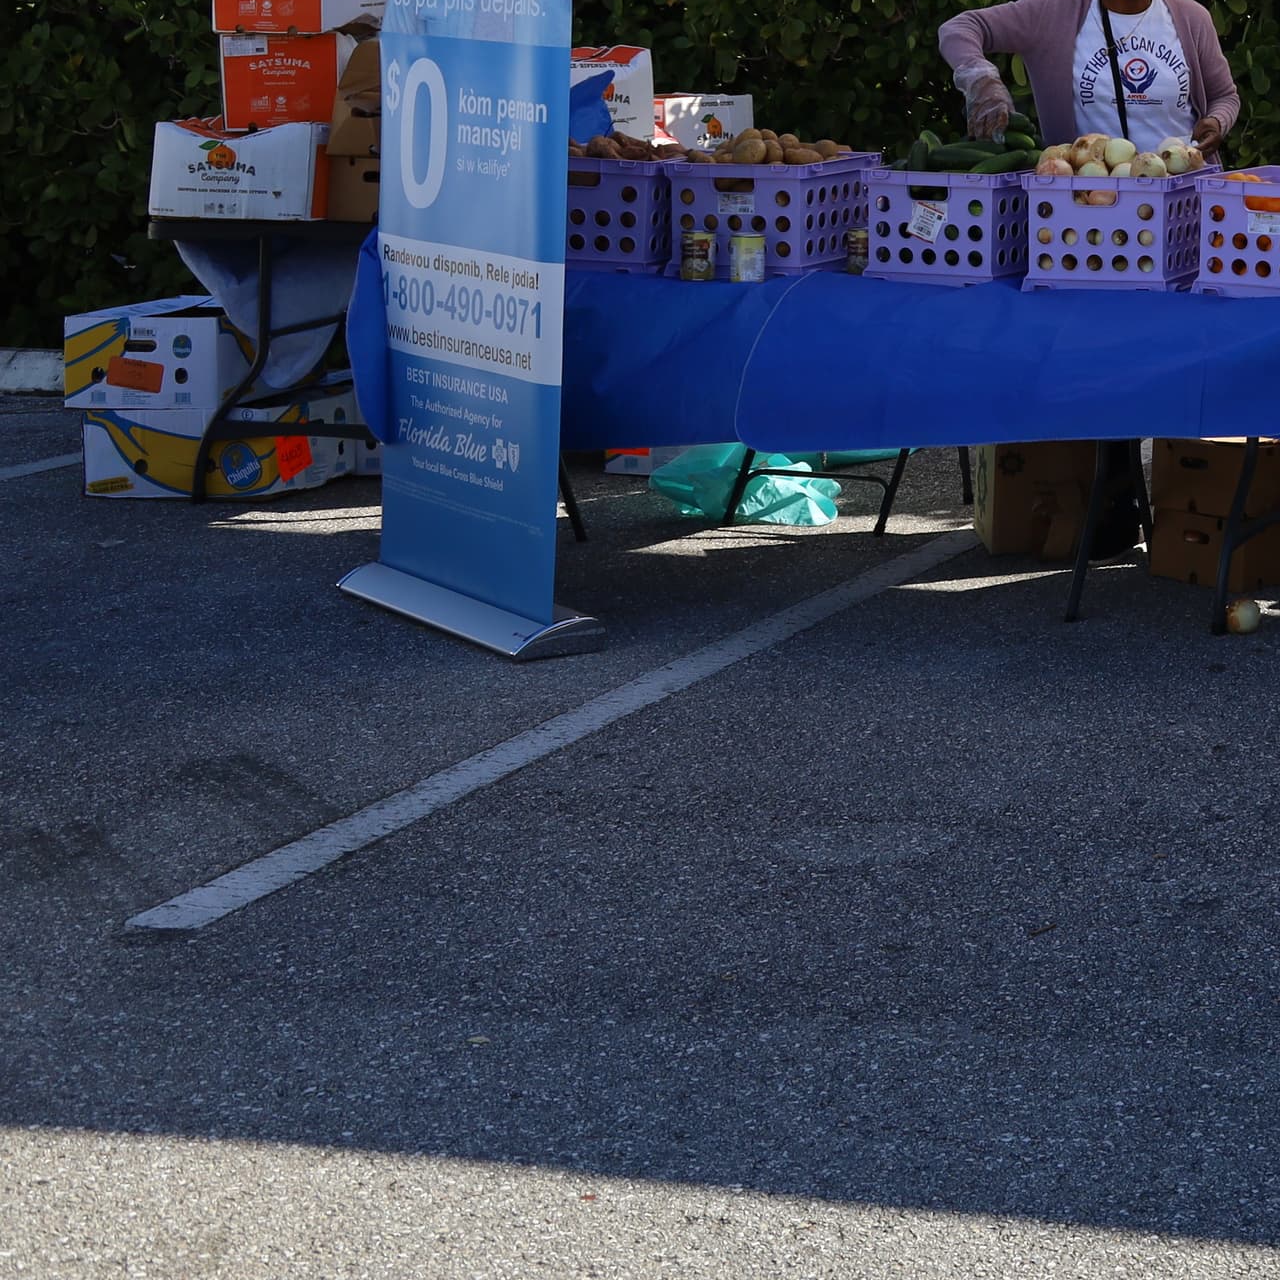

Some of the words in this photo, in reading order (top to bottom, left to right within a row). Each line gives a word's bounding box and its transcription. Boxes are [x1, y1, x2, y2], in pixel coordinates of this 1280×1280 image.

[249, 58, 311, 71] SATSUMA
[1131, 35, 1155, 53] CAN
[1155, 44, 1185, 73] SAVE
[262, 69, 296, 79] Company
[458, 87, 492, 117] kòm
[497, 98, 548, 124] peman
[457, 124, 522, 156] mansyèl
[187, 160, 257, 177] SATSUMA
[200, 173, 241, 184] Company
[383, 243, 430, 269] Randevou
[433, 254, 484, 282] disponib,
[486, 262, 510, 284] Rele
[511, 267, 540, 291] jodia!
[383, 271, 543, 340] 1-800-490-0971
[387, 323, 532, 371] www.bestinsuranceusa.net
[406, 367, 430, 385] BEST
[432, 372, 486, 400] INSURANCE
[488, 386, 509, 405] USA
[410, 394, 424, 409] The
[424, 399, 462, 420] Authorized
[463, 408, 491, 429] Agency
[491, 414, 503, 429] for
[398, 417, 452, 453] Florida
[453, 432, 488, 463] Blue
[227, 459, 262, 487] Chiquita
[469, 472, 484, 486] Blue
[484, 475, 504, 492] Shield
